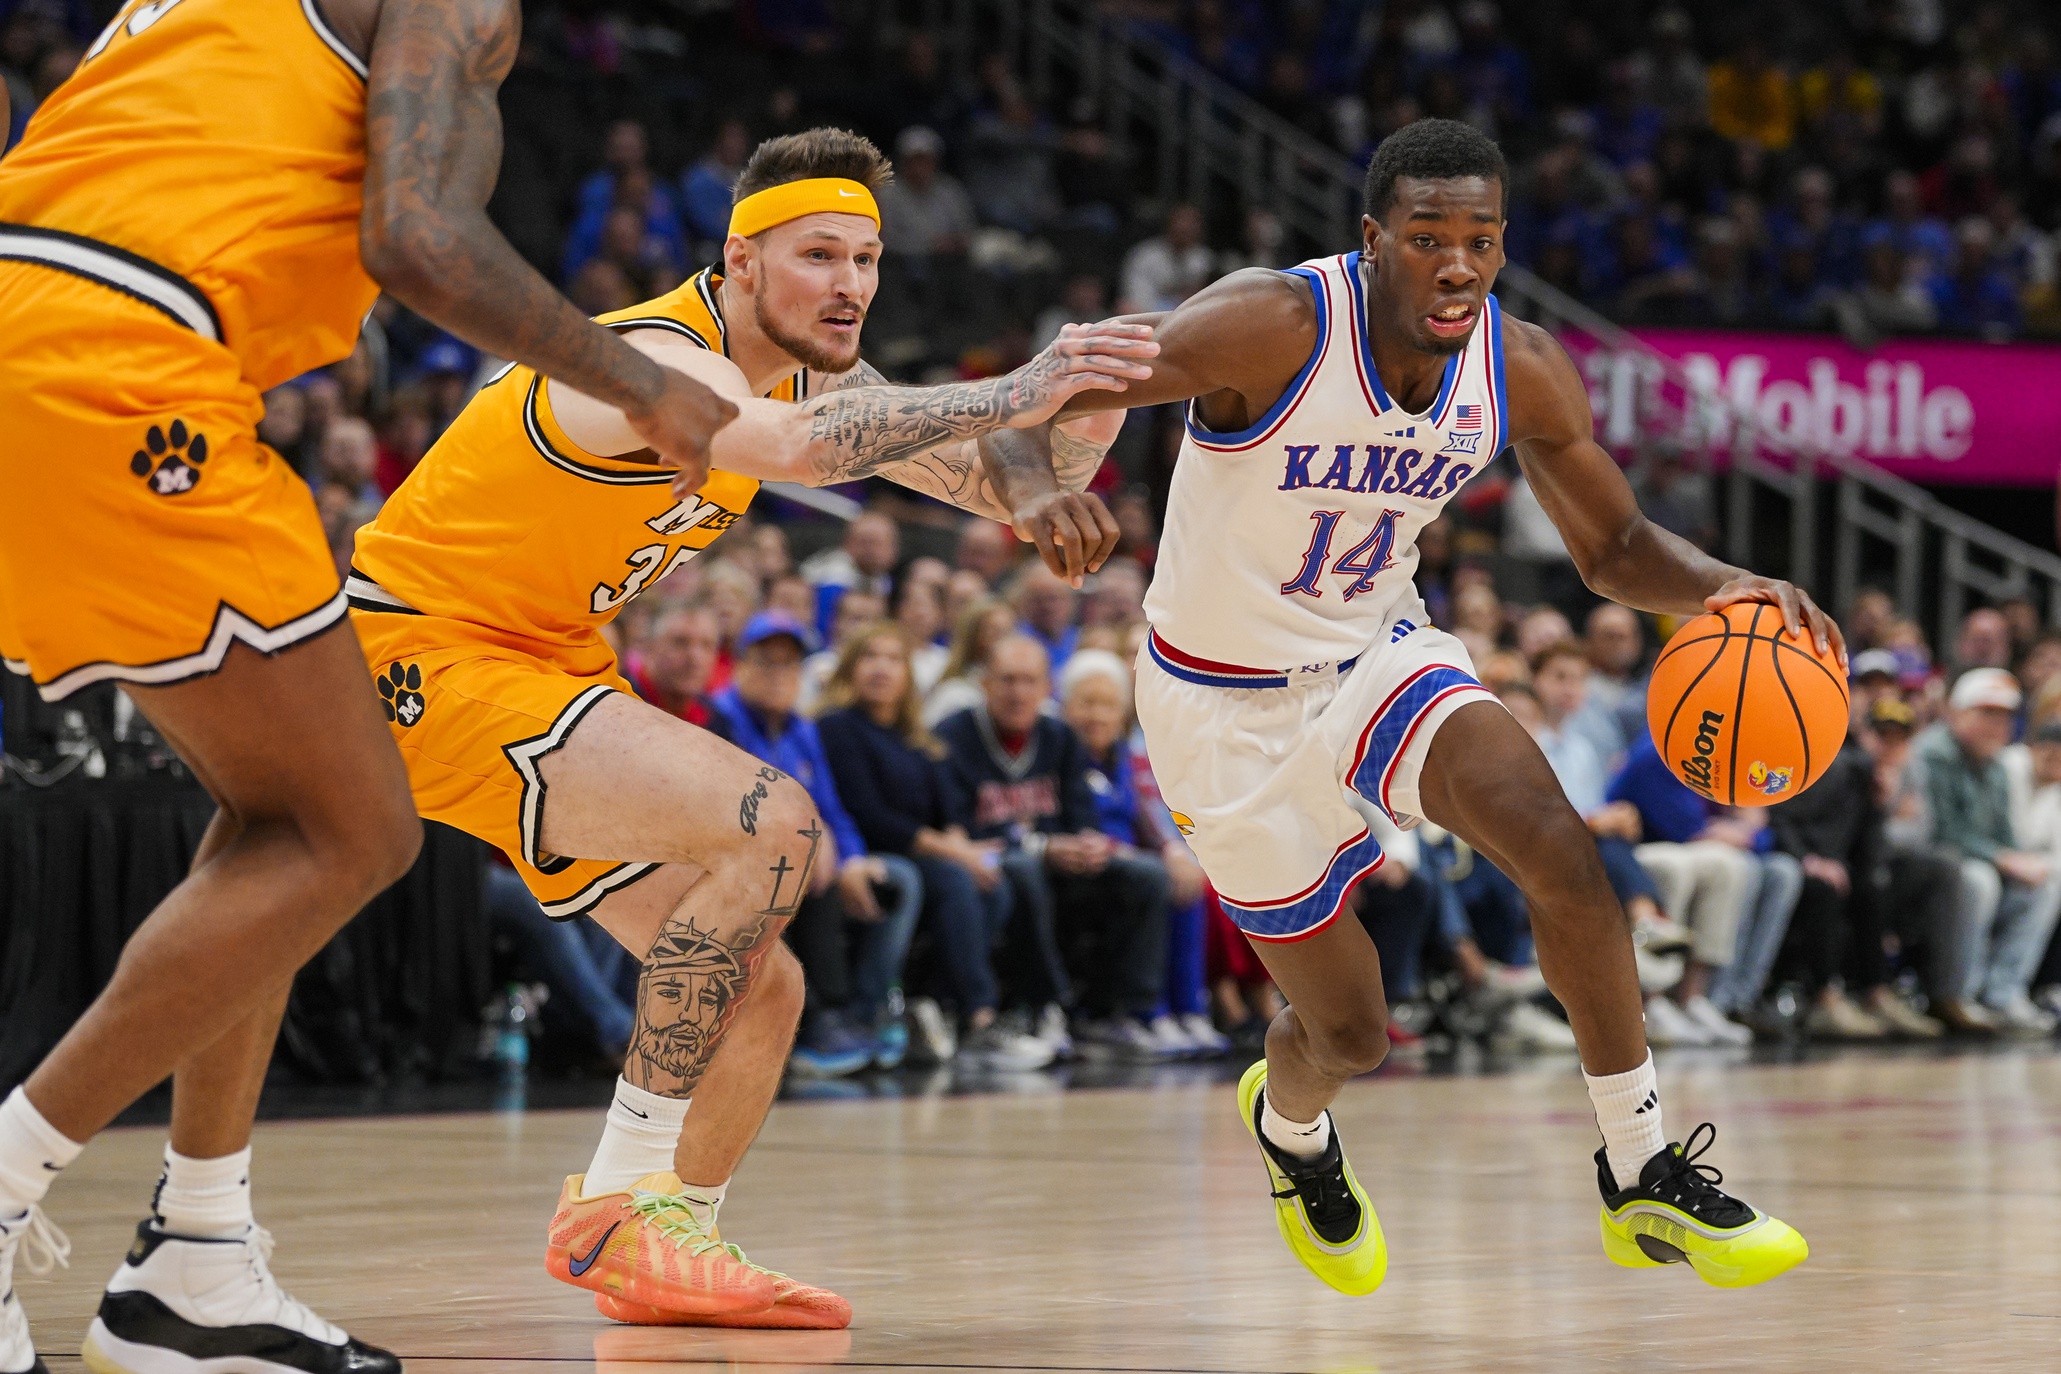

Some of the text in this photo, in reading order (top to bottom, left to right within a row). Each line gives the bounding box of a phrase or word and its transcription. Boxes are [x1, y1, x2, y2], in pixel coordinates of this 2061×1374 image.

[809, 404, 827, 441] YEA
[1682, 352, 1975, 462] Mobile
[834, 424, 843, 446] WALK
[155, 466, 193, 494] M
[1278, 444, 1475, 500] KANSAS
[1281, 508, 1405, 603] 14
[397, 695, 422, 725] M
[740, 781, 768, 836] King
